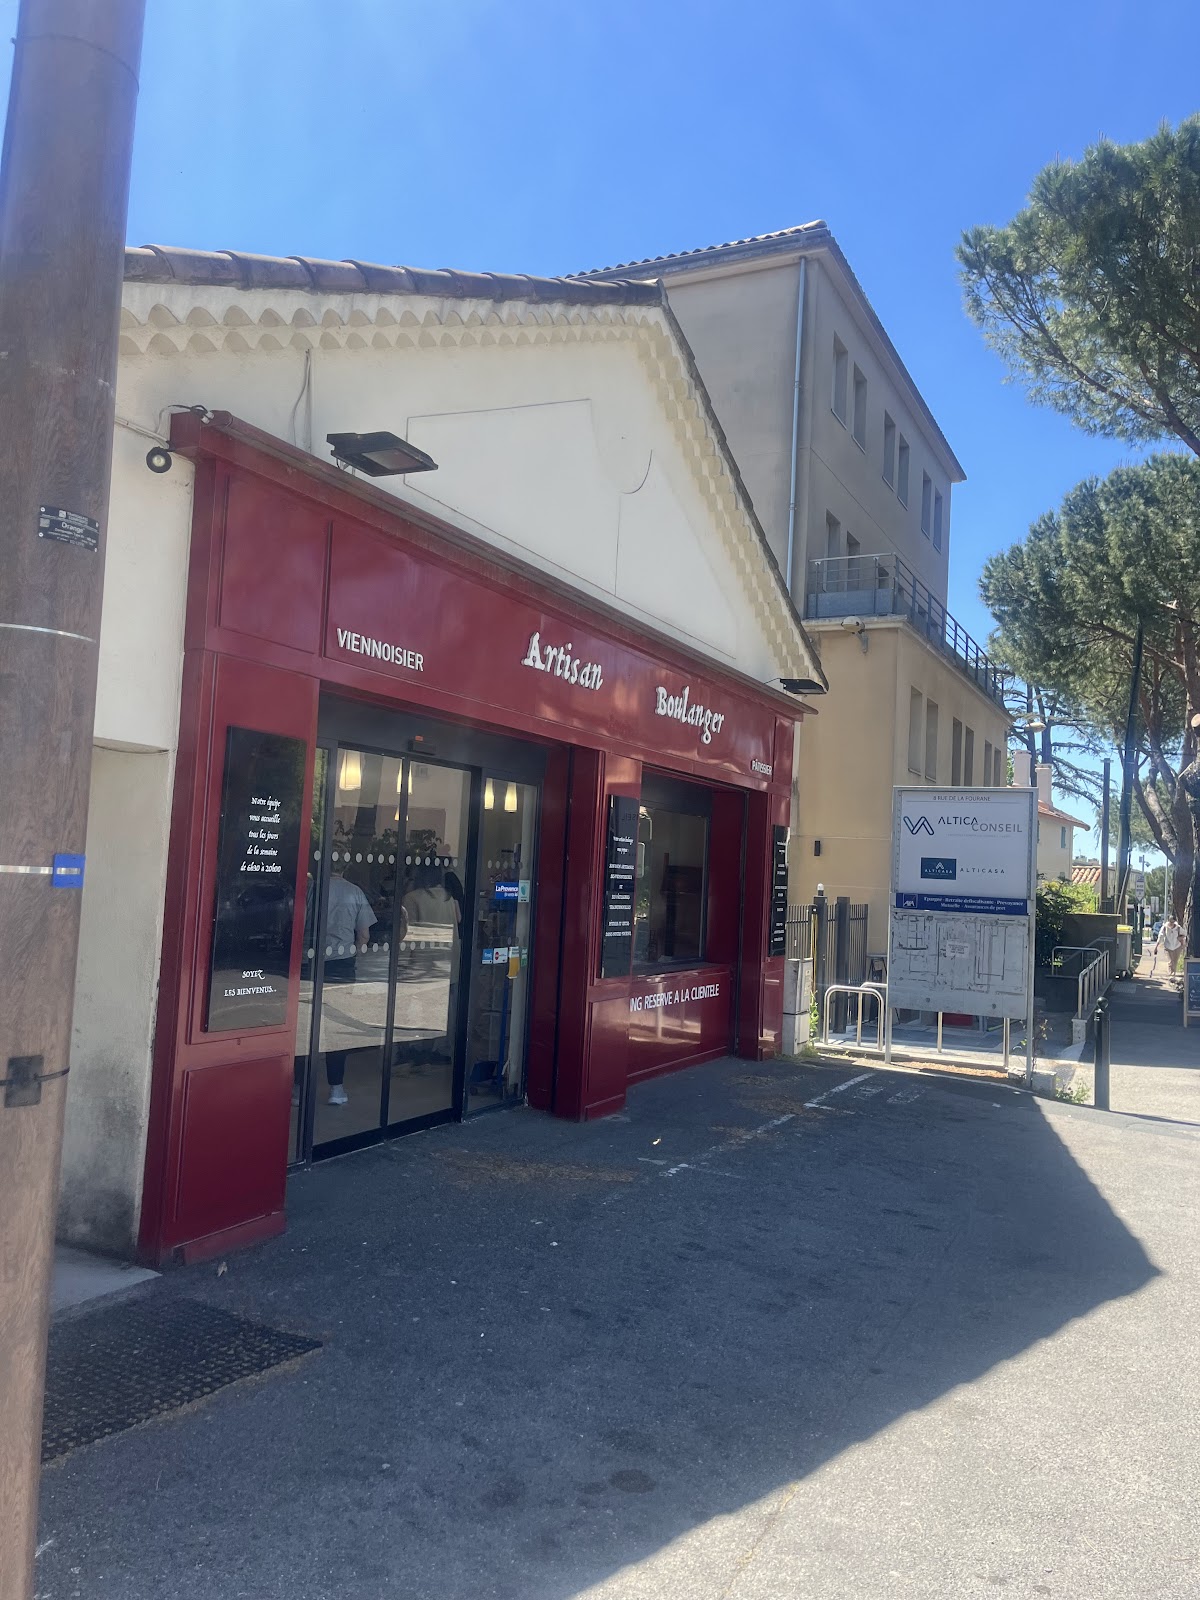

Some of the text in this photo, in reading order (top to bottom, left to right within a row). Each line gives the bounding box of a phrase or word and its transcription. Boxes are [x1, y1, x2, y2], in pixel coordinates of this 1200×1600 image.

[336, 627, 424, 672] VIENNOISIER
[521, 632, 604, 691] Artisan
[655, 685, 725, 744] Boulanger
[251, 796, 281, 811] Notre équipe
[249, 814, 280, 823] vous accueille
[938, 816, 978, 825] ALTICA
[971, 823, 1023, 833] CONSEIL
[248, 830, 259, 838] tous
[265, 831, 279, 842] jours
[246, 845, 278, 856] de la semaine
[240, 861, 246, 871] de
[247, 862, 260, 872] 6h30
[265, 863, 281, 872] 20h00
[241, 969, 266, 980] SOYEZ
[223, 988, 236, 997] LES
[644, 991, 673, 1010] RESERVE
[673, 990, 680, 1004] A
[681, 988, 690, 1003] LA
[691, 984, 720, 1001] CLIENTELE
